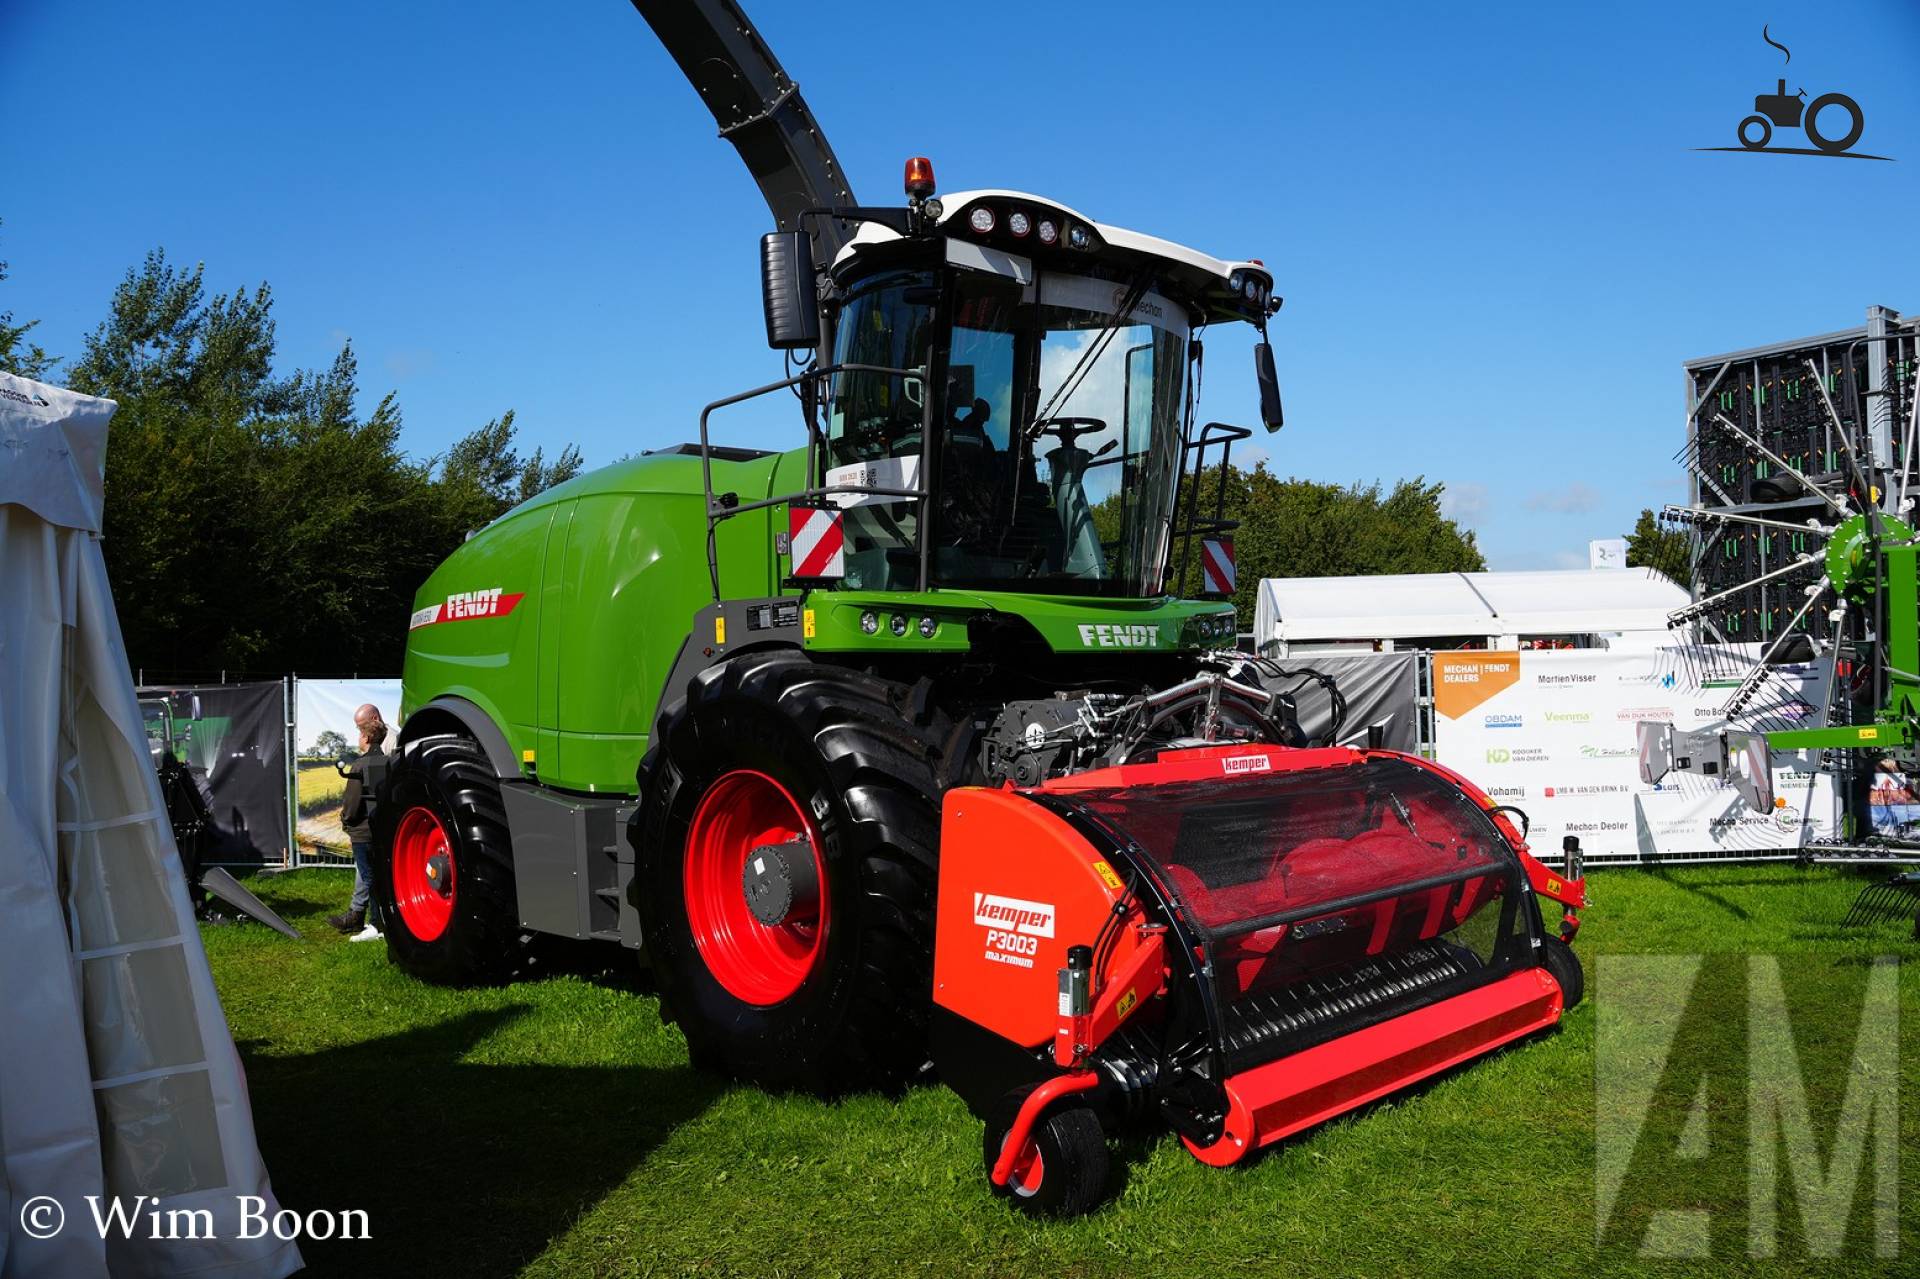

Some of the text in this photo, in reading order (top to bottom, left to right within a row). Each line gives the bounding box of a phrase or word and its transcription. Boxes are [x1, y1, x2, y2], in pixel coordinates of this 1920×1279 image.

[447, 588, 503, 619] FENDT
[1078, 624, 1160, 647] FENDT
[1443, 664, 1511, 674] MECHAN FENDT
[1443, 674, 1480, 683] DEALERS
[1538, 673, 1597, 684] Martien Visser
[1544, 711, 1590, 722] Veenma
[1694, 708, 1711, 717] Otto
[1485, 714, 1523, 723] OBDAM
[1224, 756, 1267, 771] kemper
[1566, 821, 1628, 832] Mechan Dealer
[1740, 816, 1769, 826] Service
[976, 893, 1051, 932] kemper
[986, 930, 1038, 955] P3003
[985, 950, 1034, 968] maximum
